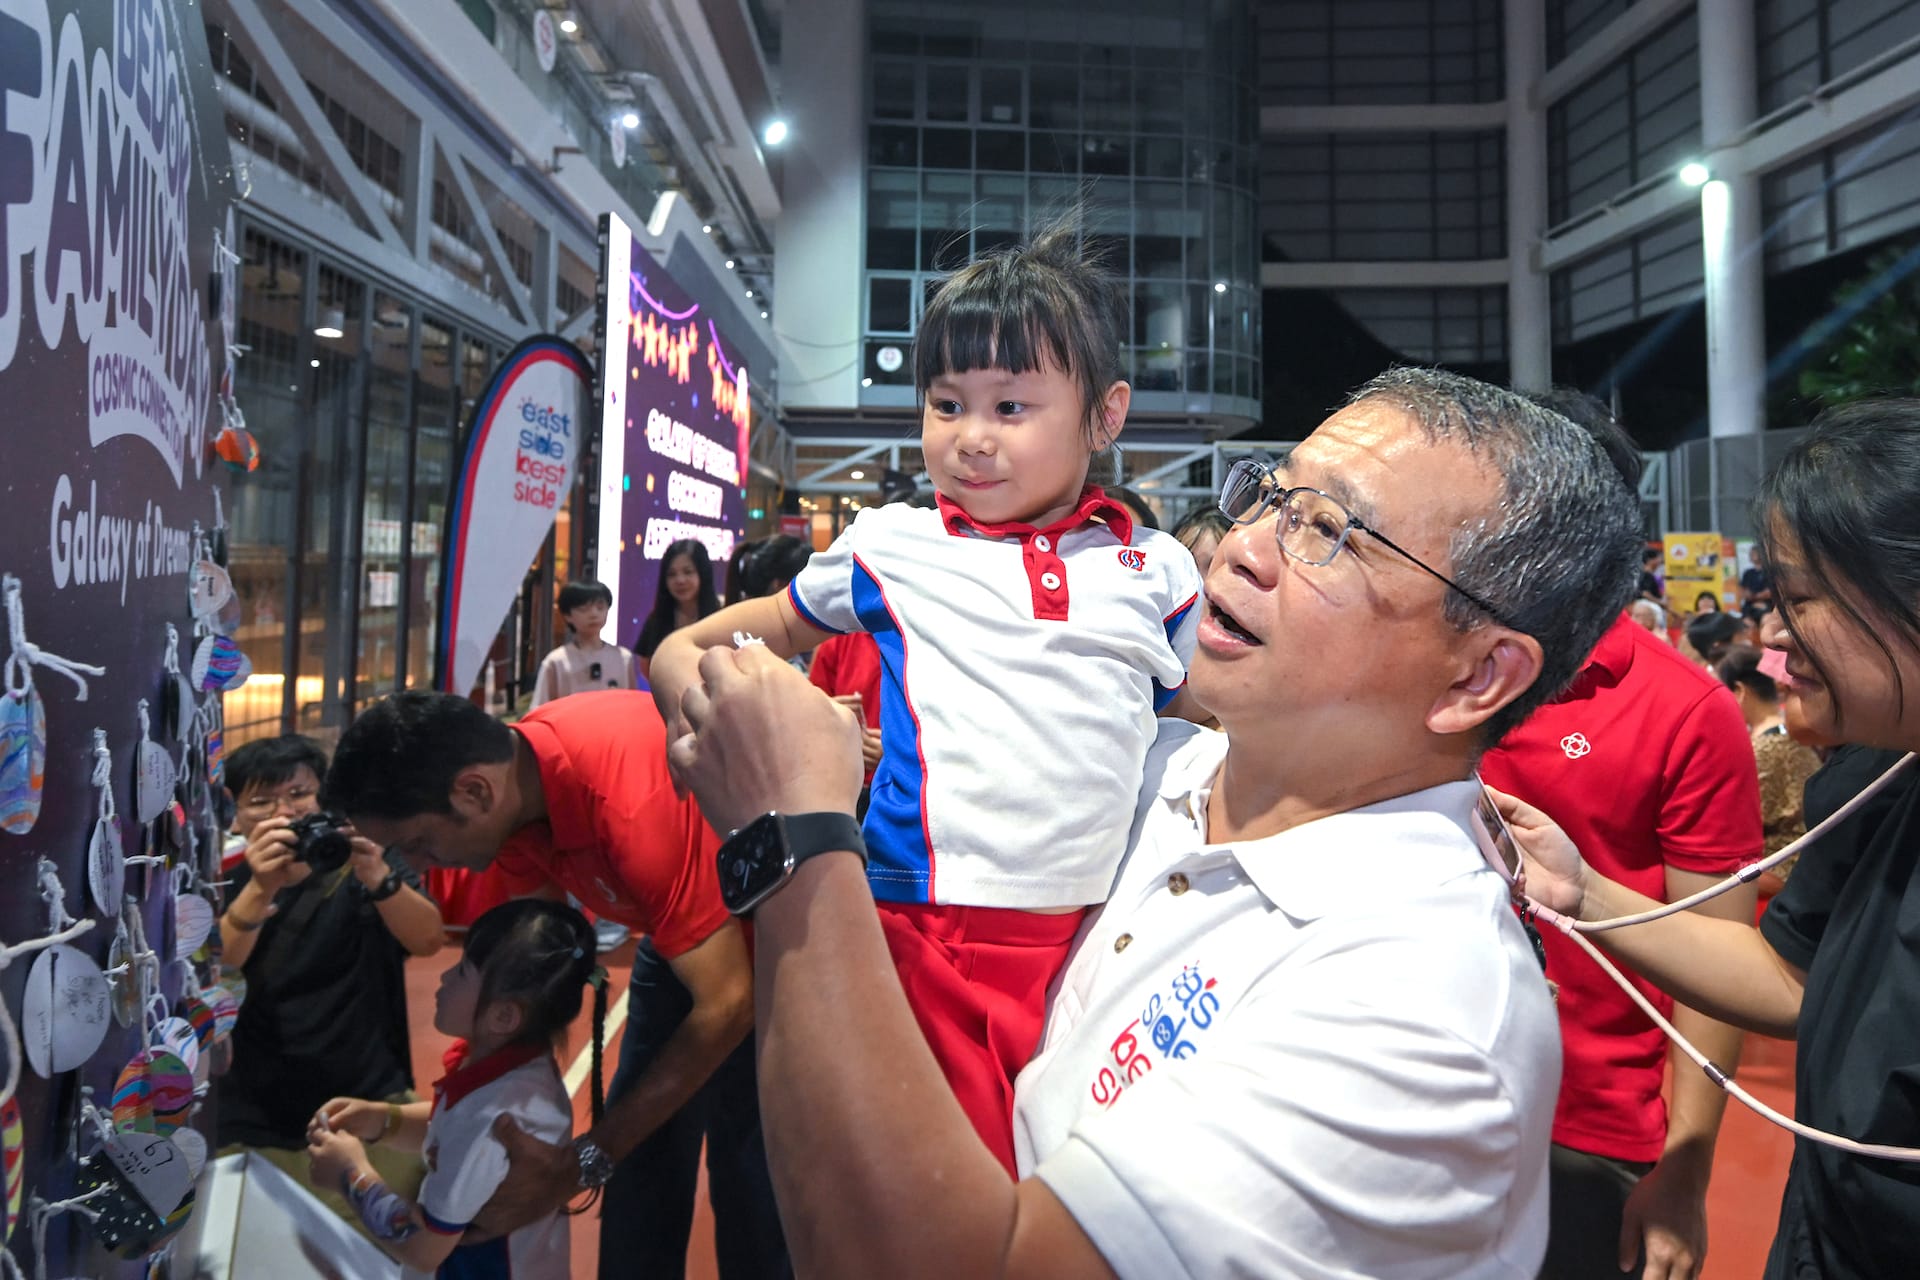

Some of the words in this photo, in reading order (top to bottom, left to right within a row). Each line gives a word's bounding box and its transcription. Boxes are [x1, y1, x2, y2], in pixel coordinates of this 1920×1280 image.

[93, 352, 138, 417] COSMIC
[521, 402, 571, 438] east
[518, 427, 565, 460] side
[515, 447, 567, 487] best
[513, 478, 557, 510] side
[51, 474, 132, 607] Galaxy
[136, 499, 152, 580] of
[1171, 969, 1220, 1031] eas
